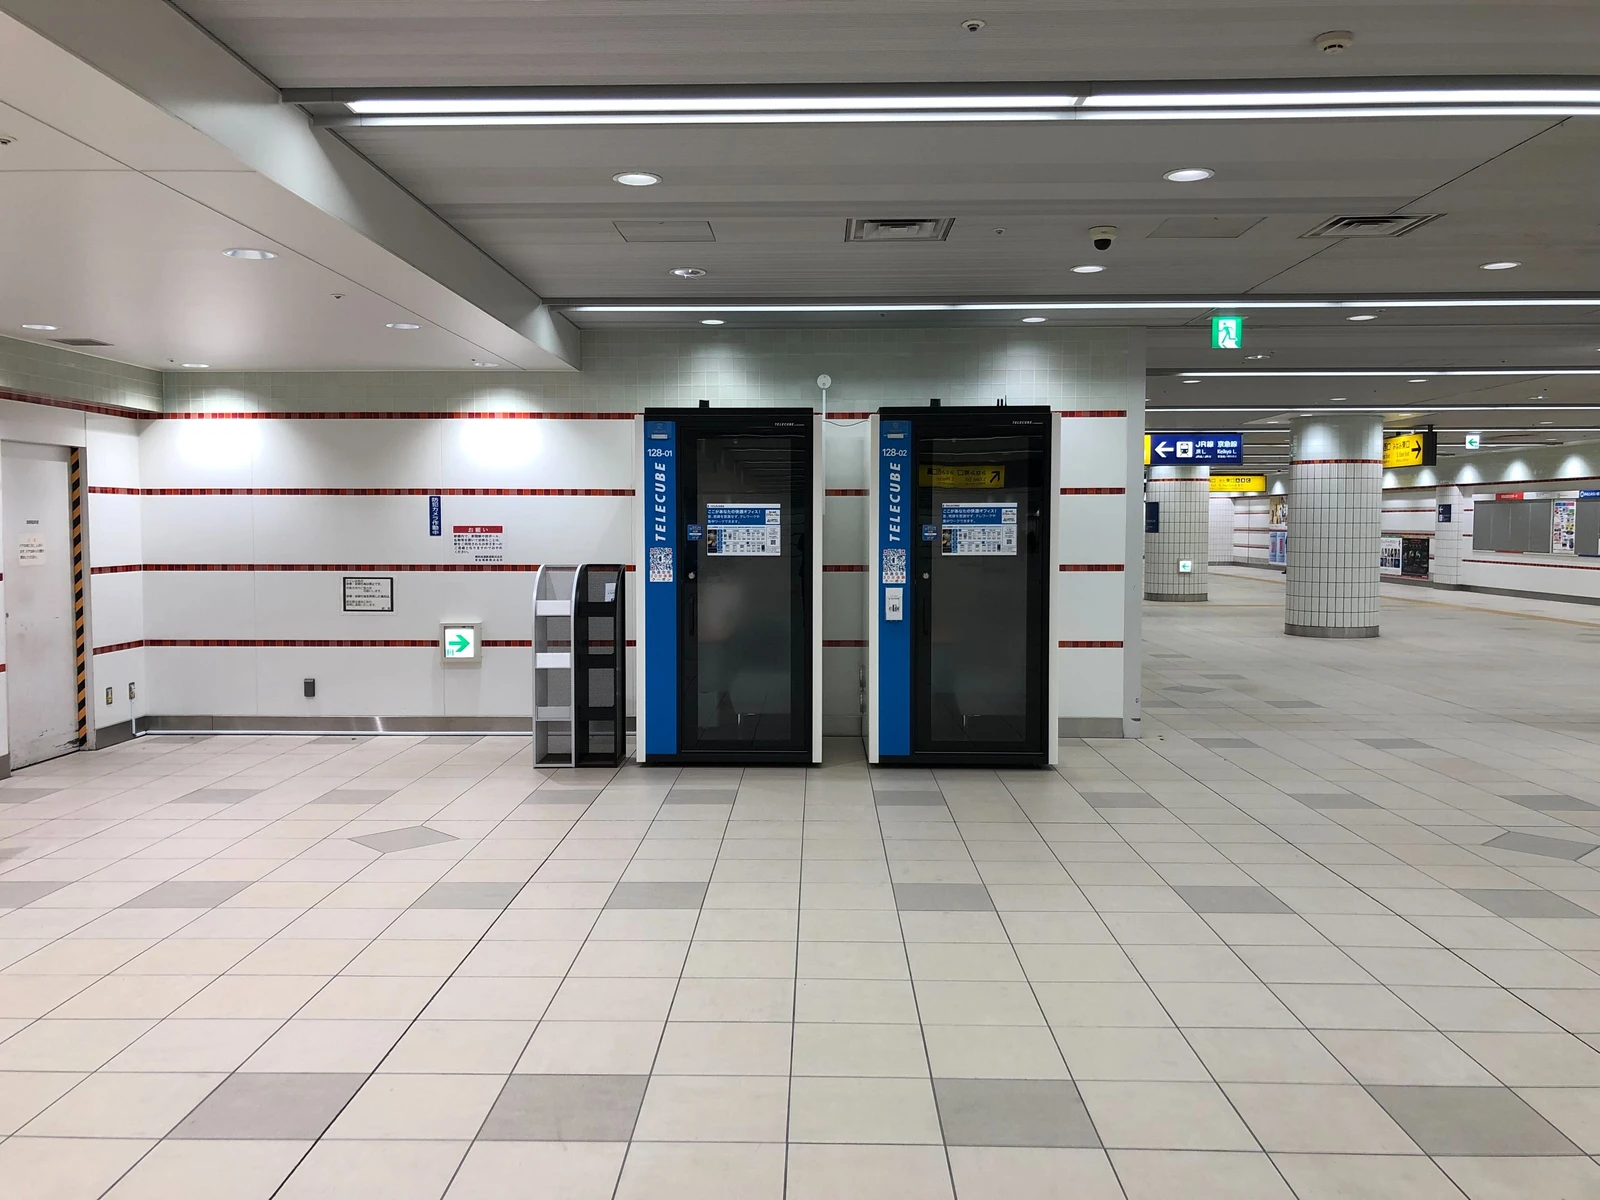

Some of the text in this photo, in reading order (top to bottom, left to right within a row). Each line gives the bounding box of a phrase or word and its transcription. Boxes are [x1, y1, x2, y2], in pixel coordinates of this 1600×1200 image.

[647, 448, 673, 457] 128-01
[882, 448, 907, 457] 128-02
[431, 497, 440, 536] 防犯カメラ作動中
[654, 462, 666, 541] TELECUBE
[889, 462, 901, 542] TELECUBE
